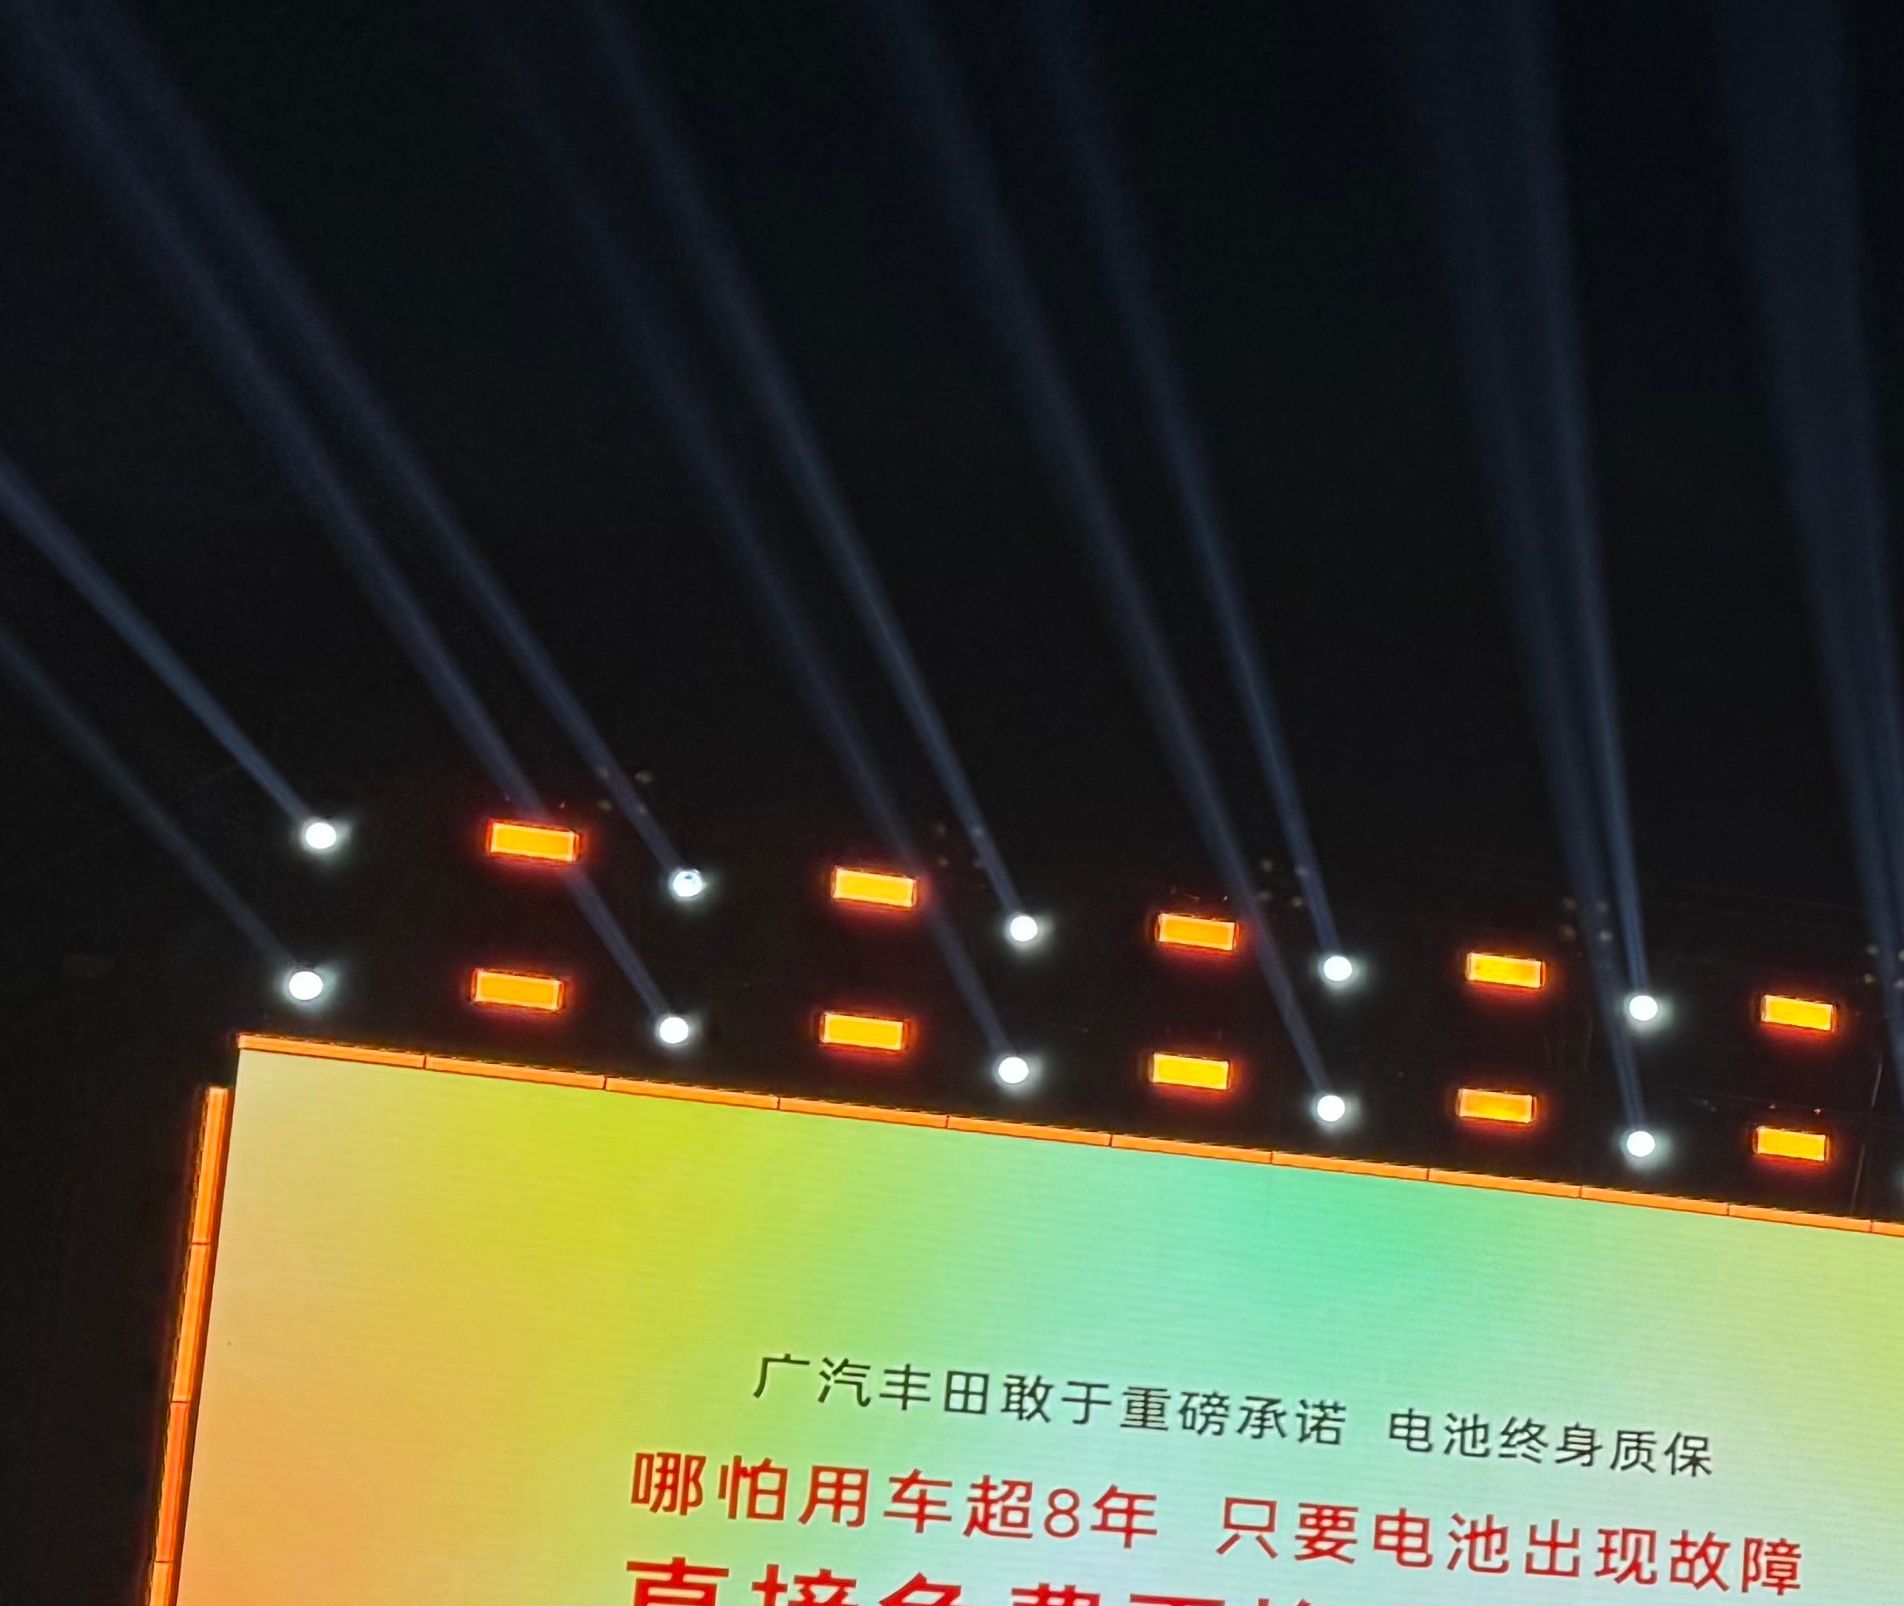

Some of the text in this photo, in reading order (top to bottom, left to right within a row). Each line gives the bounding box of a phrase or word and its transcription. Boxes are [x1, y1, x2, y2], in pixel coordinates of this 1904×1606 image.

[752, 1354, 1714, 1477] 广汽丰田敢于重磅承诺 电池终身质保
[631, 1452, 1804, 1597] 哪怕用车超8年 只要电池出现故障
